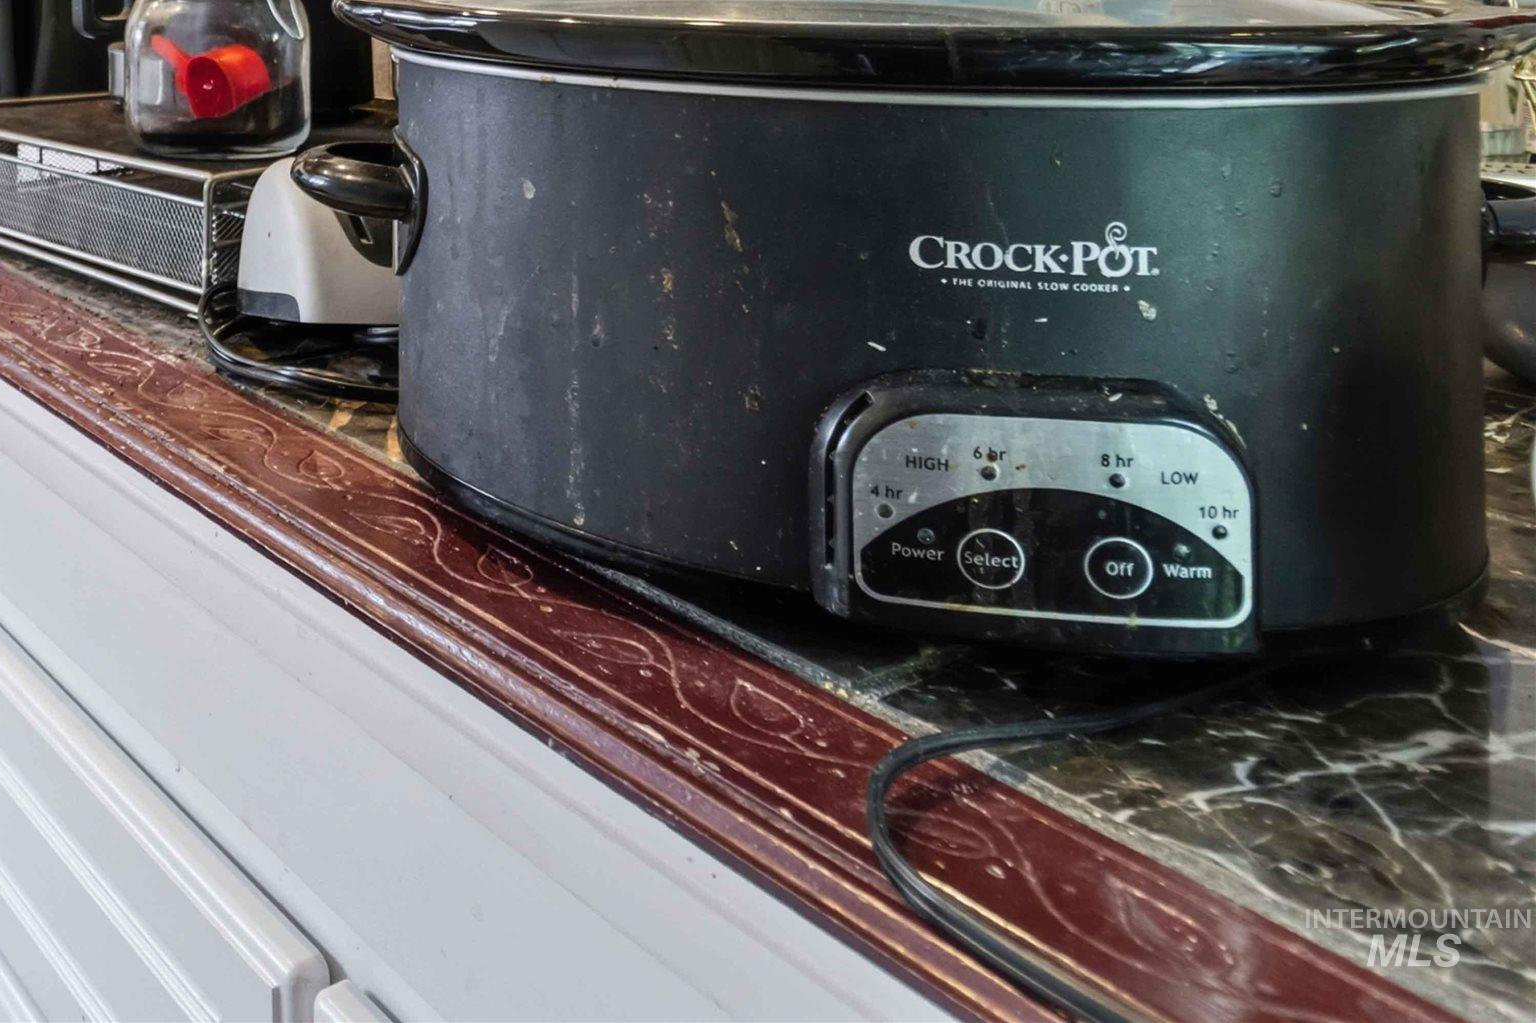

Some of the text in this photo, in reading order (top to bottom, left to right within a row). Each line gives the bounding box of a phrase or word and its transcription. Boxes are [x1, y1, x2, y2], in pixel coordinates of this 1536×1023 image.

[952, 278, 1119, 293] THE ORIGINAL SLOW COOKER
[973, 446, 982, 459] 6
[905, 455, 949, 472] HIGH
[1101, 453, 1134, 468] 8 hr
[1161, 471, 1199, 485] LOW
[870, 485, 903, 500] 4 hr
[1199, 506, 1239, 519] 10 hr
[891, 542, 945, 561] Power
[964, 551, 1019, 569] Select
[1105, 561, 1135, 577] Off
[1163, 563, 1213, 579] Warm
